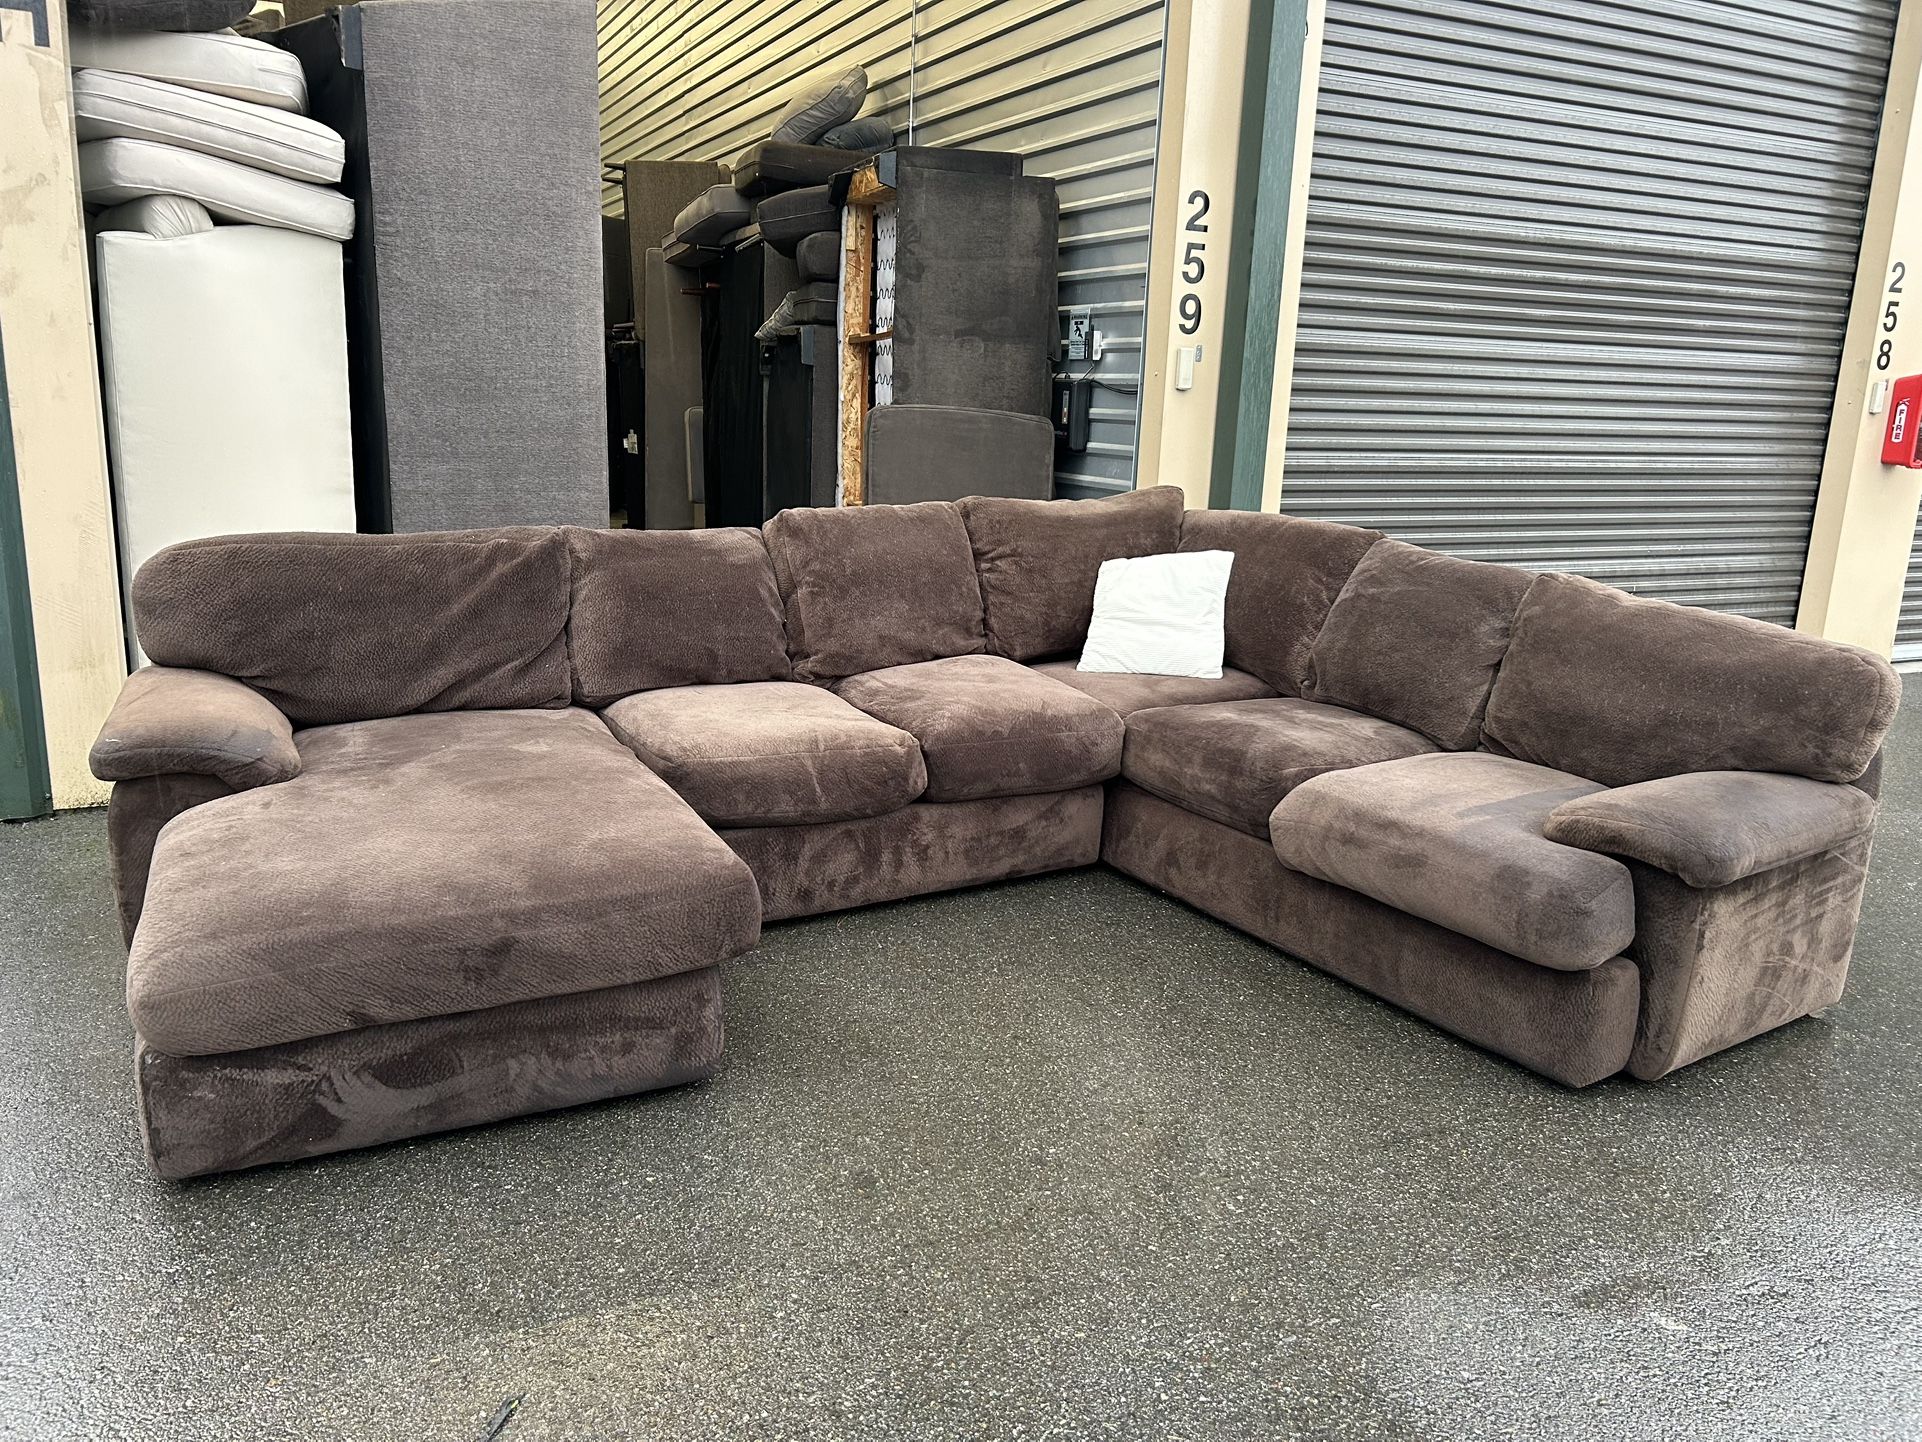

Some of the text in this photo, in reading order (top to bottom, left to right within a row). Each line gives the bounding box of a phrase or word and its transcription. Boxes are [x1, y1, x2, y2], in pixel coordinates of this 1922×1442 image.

[1178, 190, 1210, 335] 259
[1876, 261, 1906, 370] 258
[1894, 408, 1905, 440] FIRE
